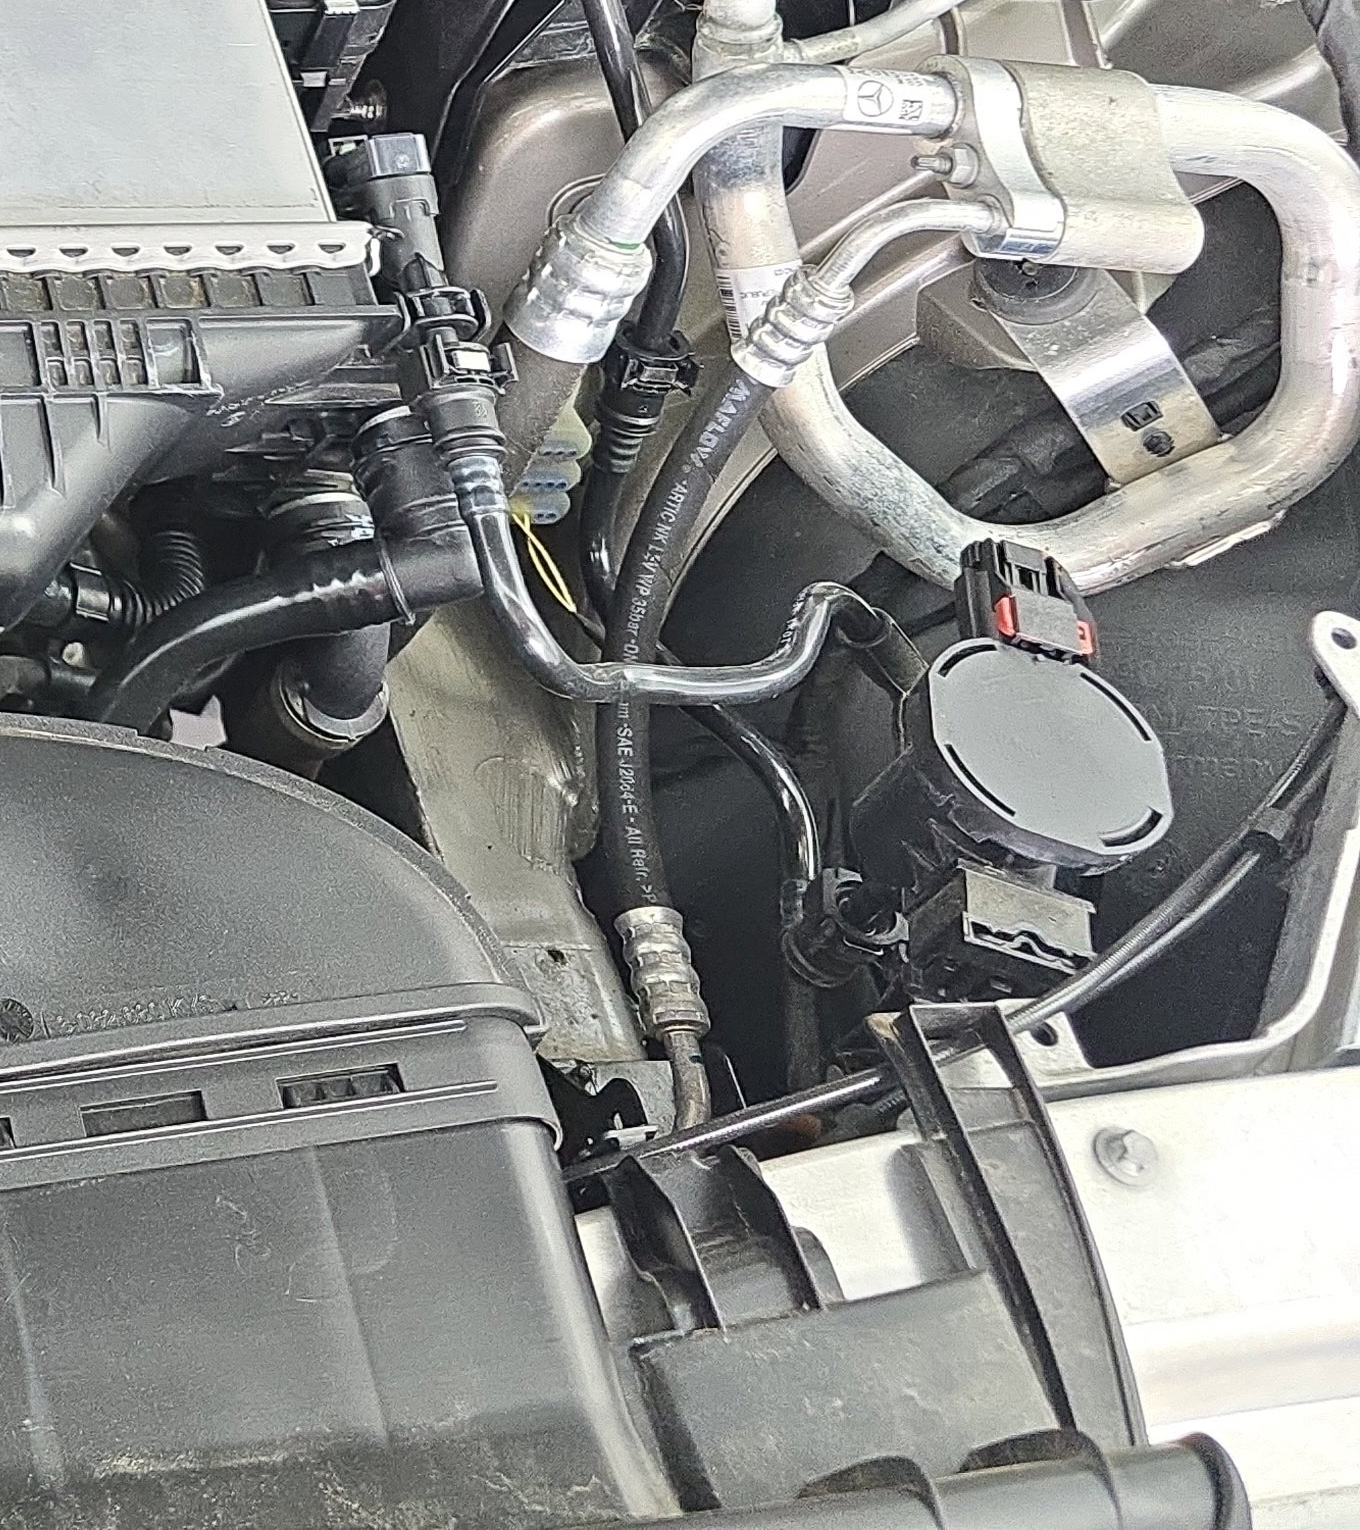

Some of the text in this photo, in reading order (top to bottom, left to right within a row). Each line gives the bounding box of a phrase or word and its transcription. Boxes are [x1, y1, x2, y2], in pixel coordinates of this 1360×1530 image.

[651, 522, 672, 545] NK
[616, 727, 633, 757] SAE
[625, 825, 644, 846] All
